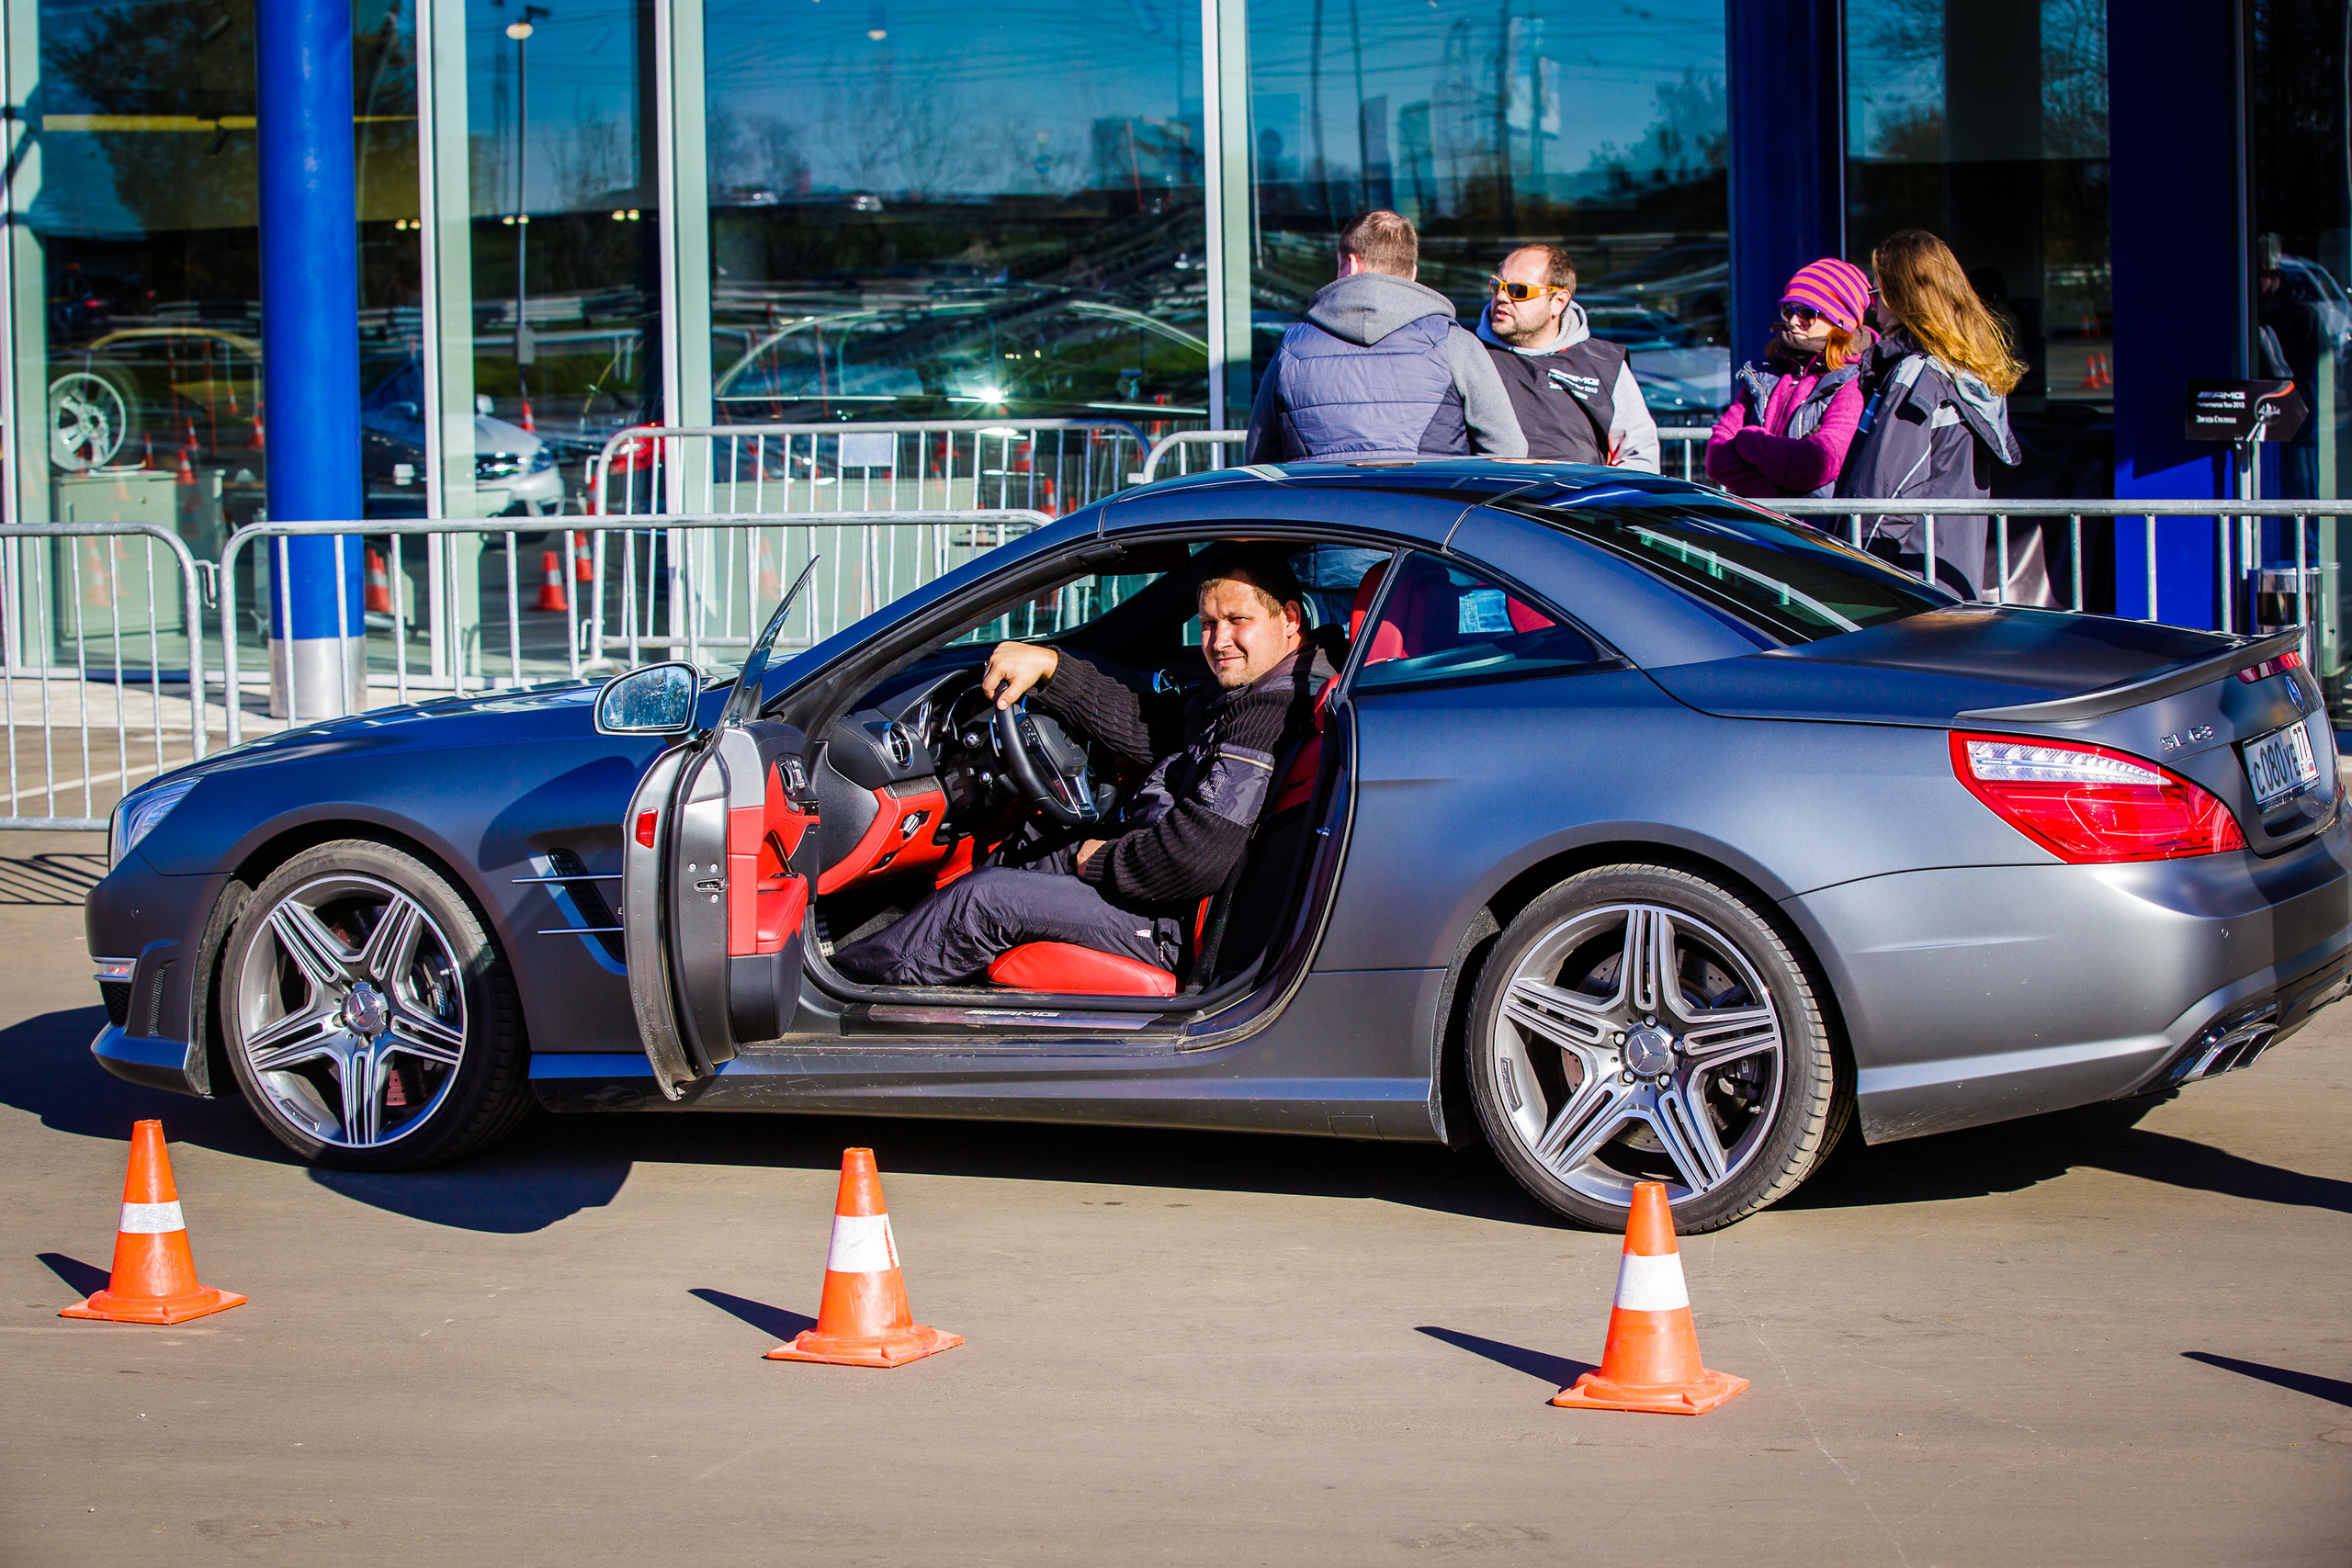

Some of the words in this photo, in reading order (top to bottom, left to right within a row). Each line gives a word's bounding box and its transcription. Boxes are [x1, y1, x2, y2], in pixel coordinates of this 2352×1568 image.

[2212, 391, 2245, 400] AMG
[2160, 733, 2187, 752] SL
[2188, 724, 2214, 743] 63
